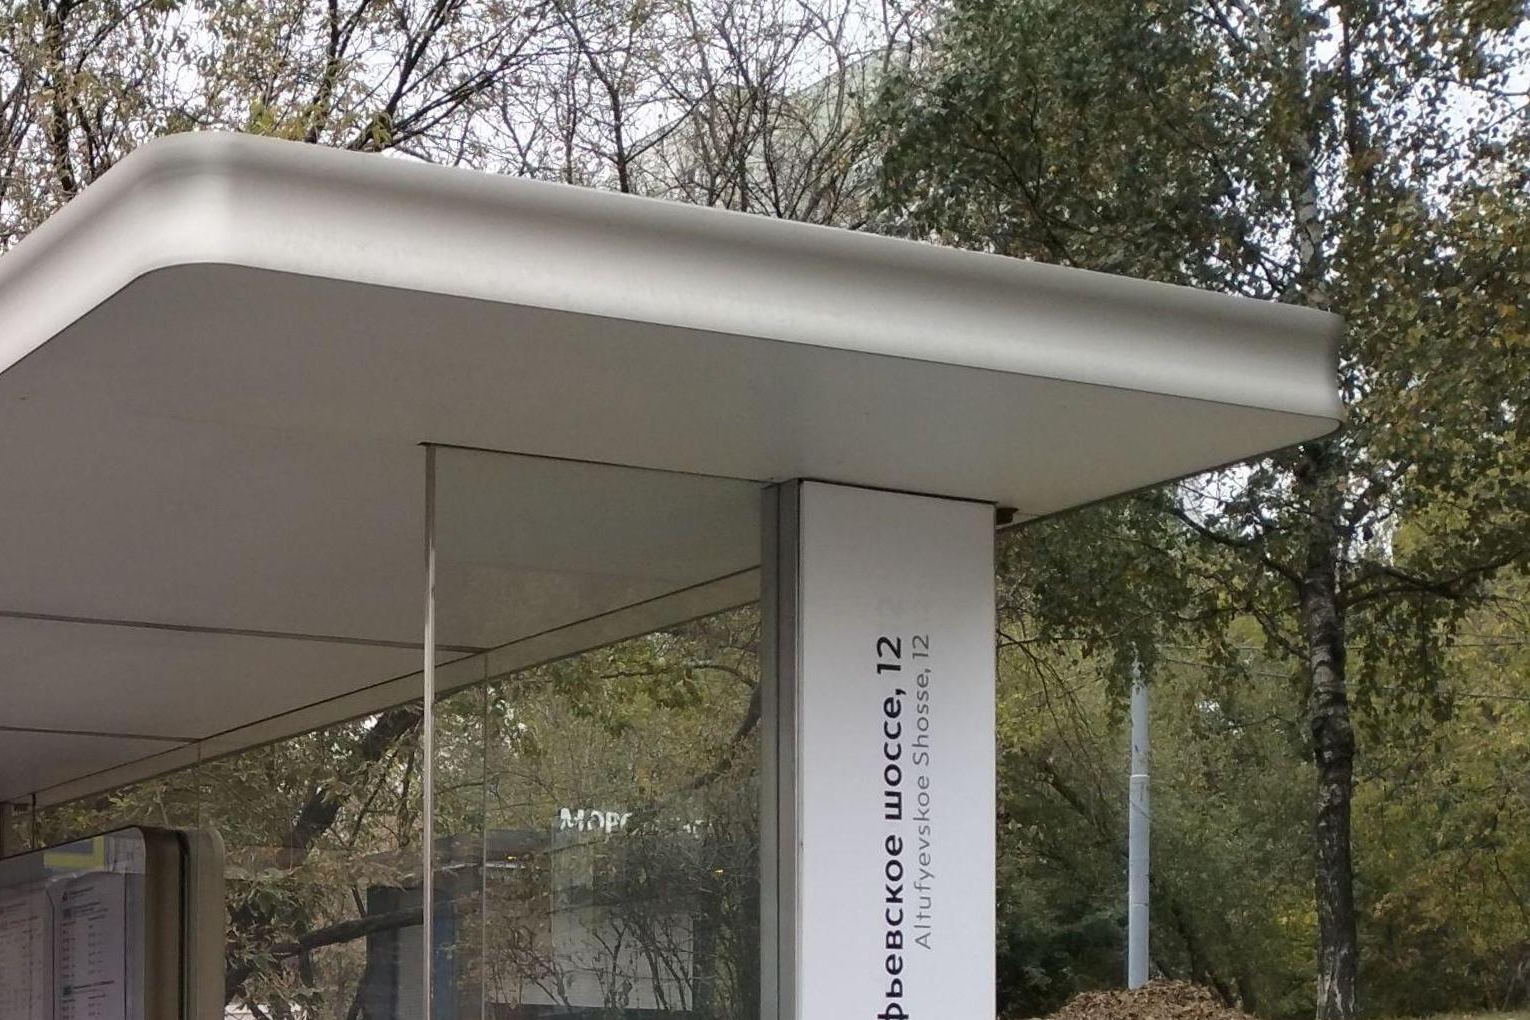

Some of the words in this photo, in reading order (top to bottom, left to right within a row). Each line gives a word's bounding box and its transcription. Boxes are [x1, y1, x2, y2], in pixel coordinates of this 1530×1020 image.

[876, 636, 902, 674] 12
[912, 634, 929, 660] 12
[883, 688, 906, 820] шоссе,
[912, 668, 932, 767] Shosse,
[913, 775, 935, 949] Altufyevskoe
